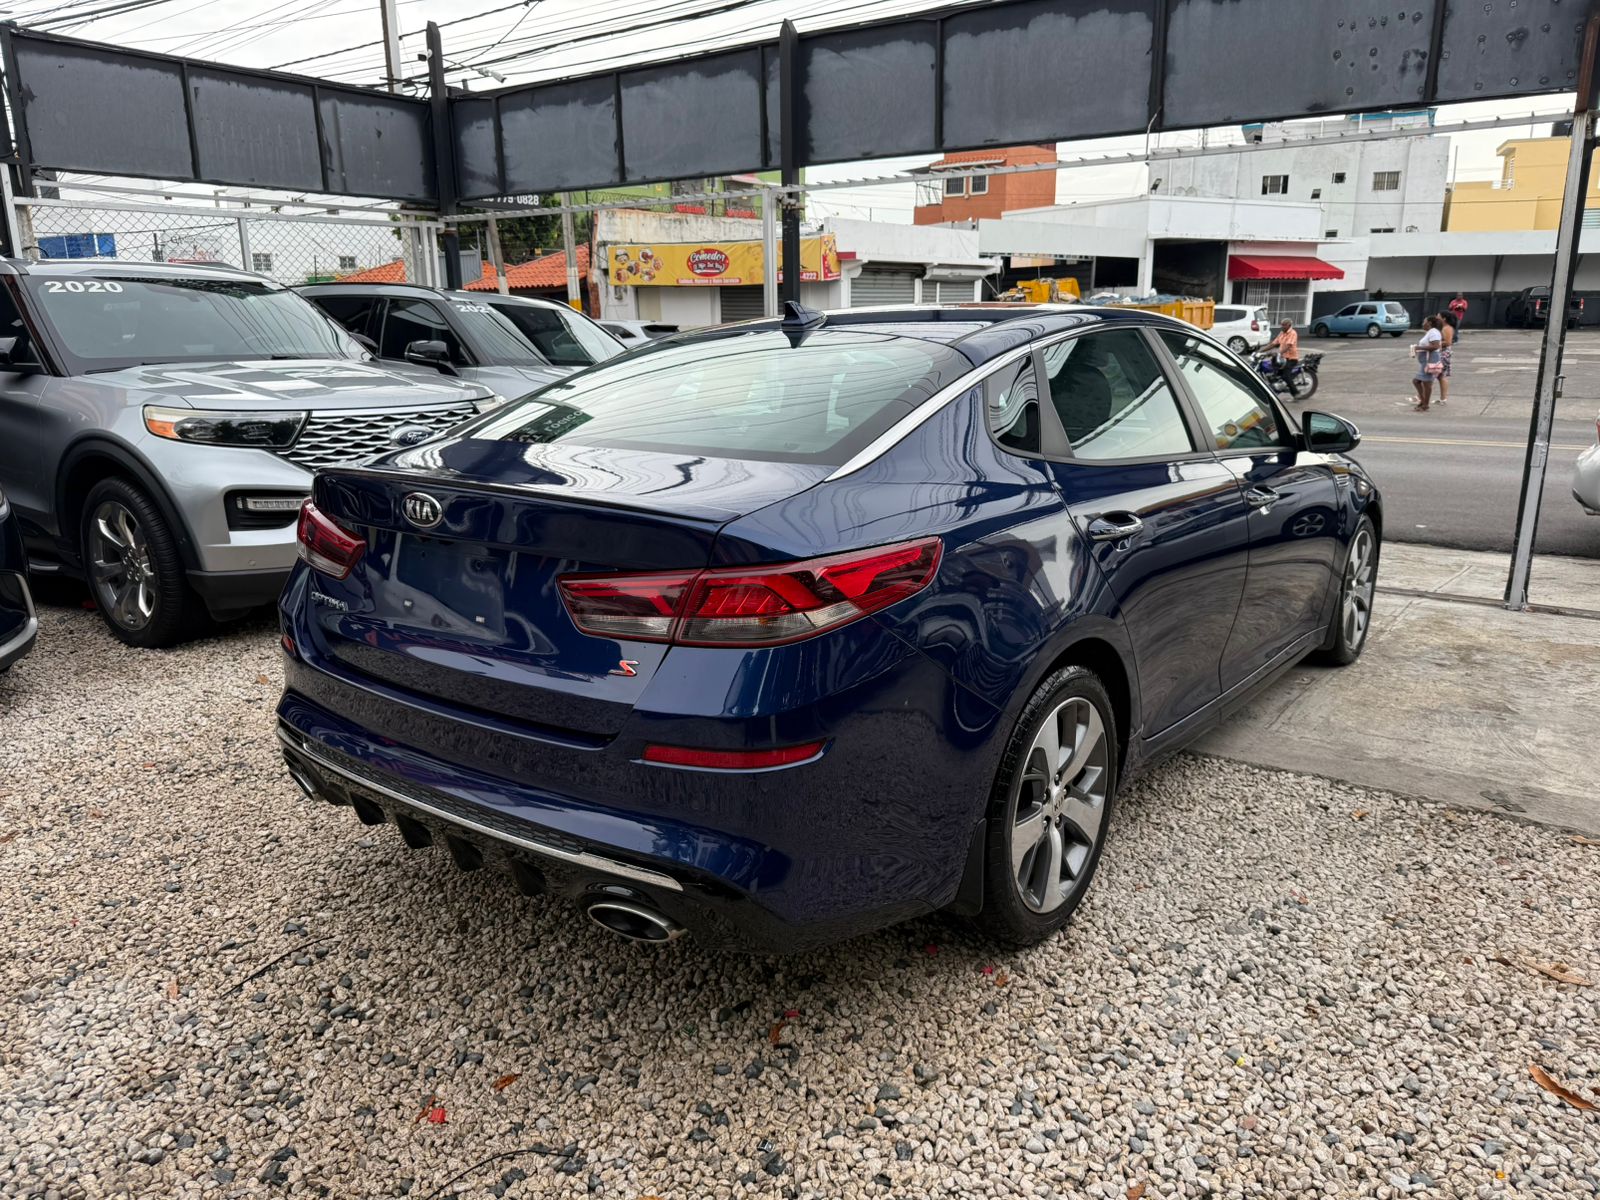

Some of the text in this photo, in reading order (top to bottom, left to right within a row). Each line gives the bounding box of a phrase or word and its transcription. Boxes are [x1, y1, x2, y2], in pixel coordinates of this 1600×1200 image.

[690, 251, 725, 263] Comedor
[44, 281, 123, 293] 2020
[407, 431, 429, 443] Ford
[405, 499, 435, 521] KIA
[311, 591, 349, 612] OPTIMA
[608, 660, 640, 677] S
